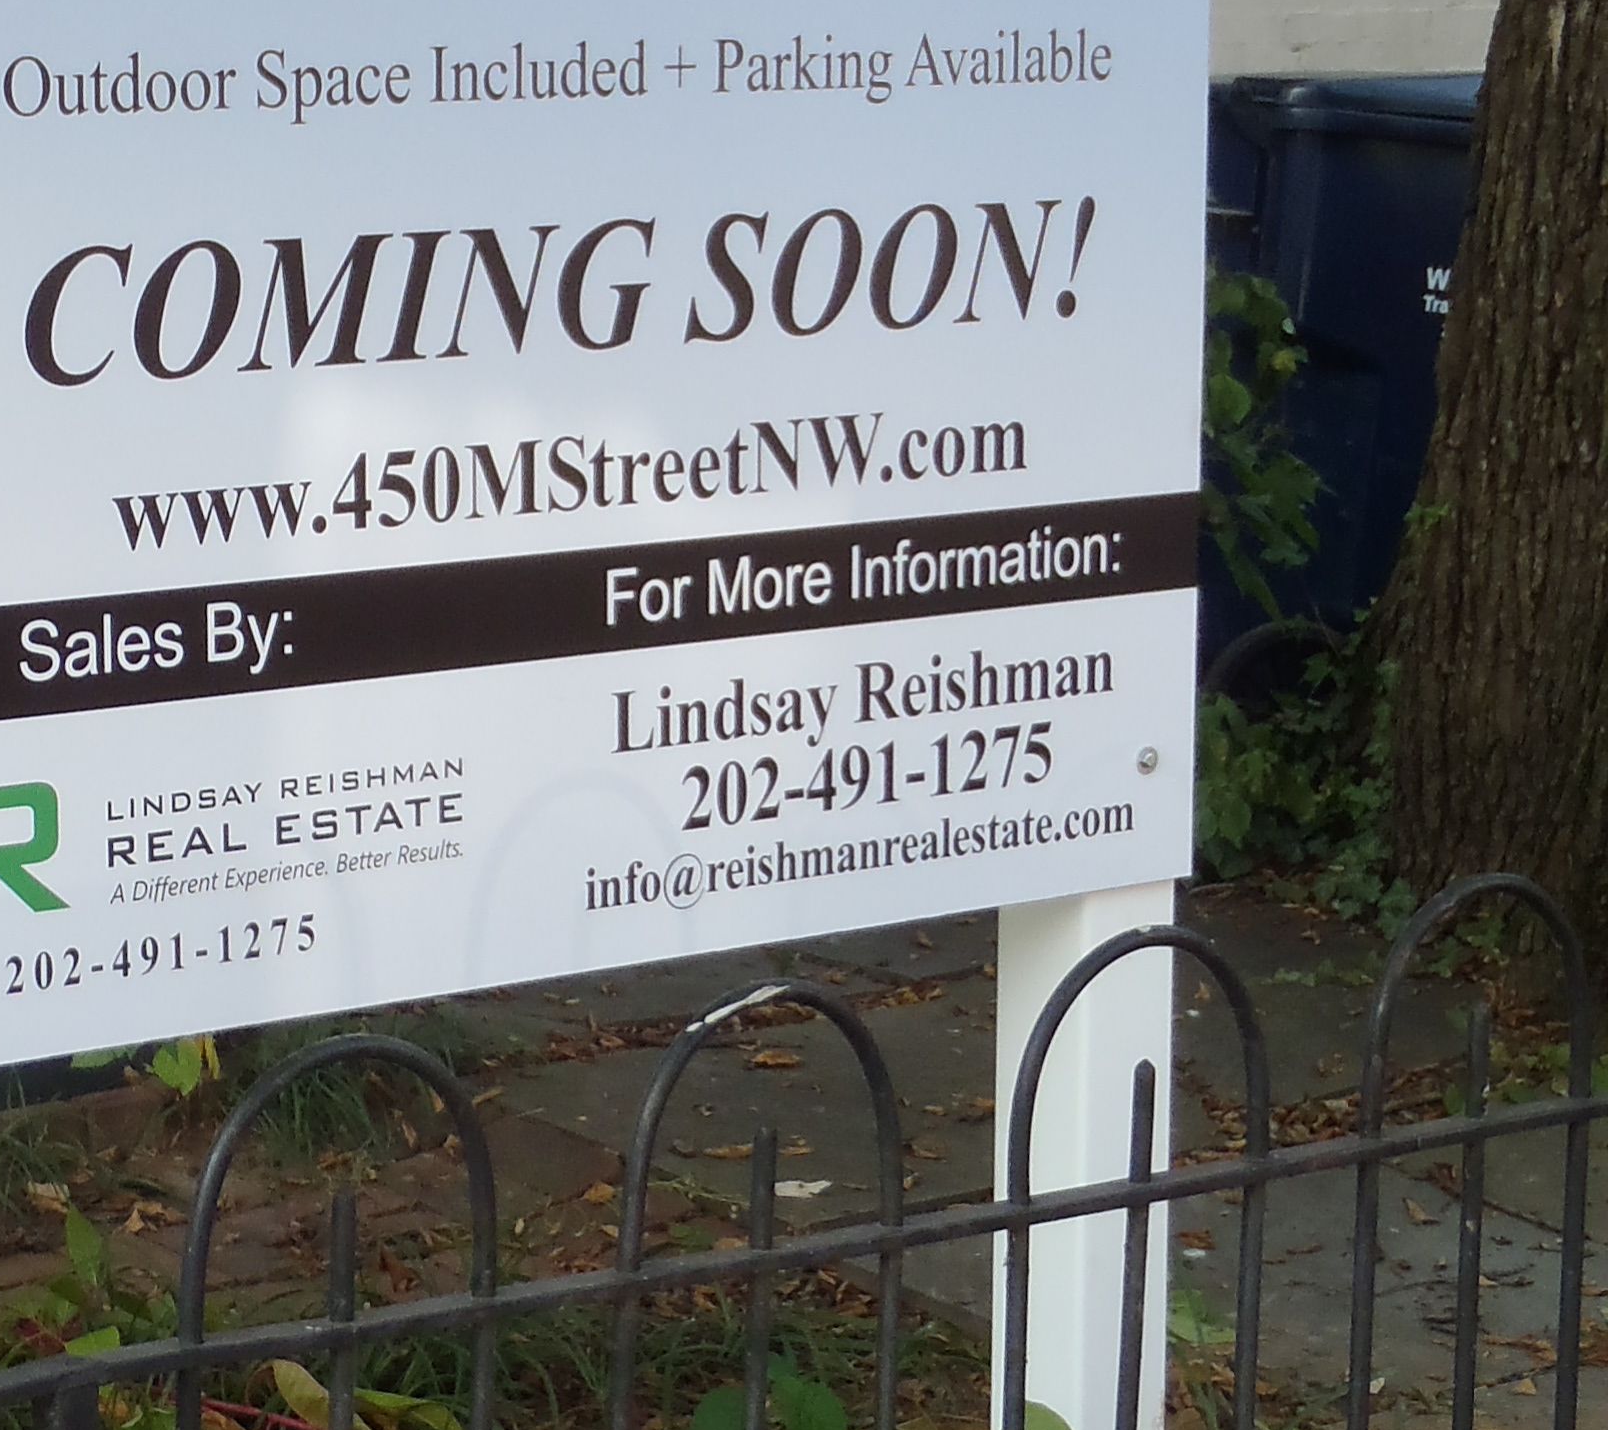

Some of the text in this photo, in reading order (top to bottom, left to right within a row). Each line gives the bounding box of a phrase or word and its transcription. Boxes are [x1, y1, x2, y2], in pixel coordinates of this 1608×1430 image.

[4, 28, 1111, 124] Outdoor Space Included + Parking Available
[25, 196, 1095, 386] COMING SOON!
[1423, 294, 1449, 314] Tra
[1426, 266, 1451, 291] W
[112, 413, 1026, 551] www.450MStreetNW.com
[607, 526, 1120, 625] For More Information:
[20, 602, 292, 681] Sales By:
[613, 651, 1113, 753] Lindsay Reishman
[108, 759, 462, 820] LINDSAY REISHMAN
[683, 722, 1051, 830] 202-491-1275
[108, 793, 462, 867] REAL ESTATE
[110, 839, 463, 904] A Different Experience. Better Results.
[587, 804, 1133, 910] info@reishmanrealestate.com
[7, 915, 314, 994] 202-491-1275
